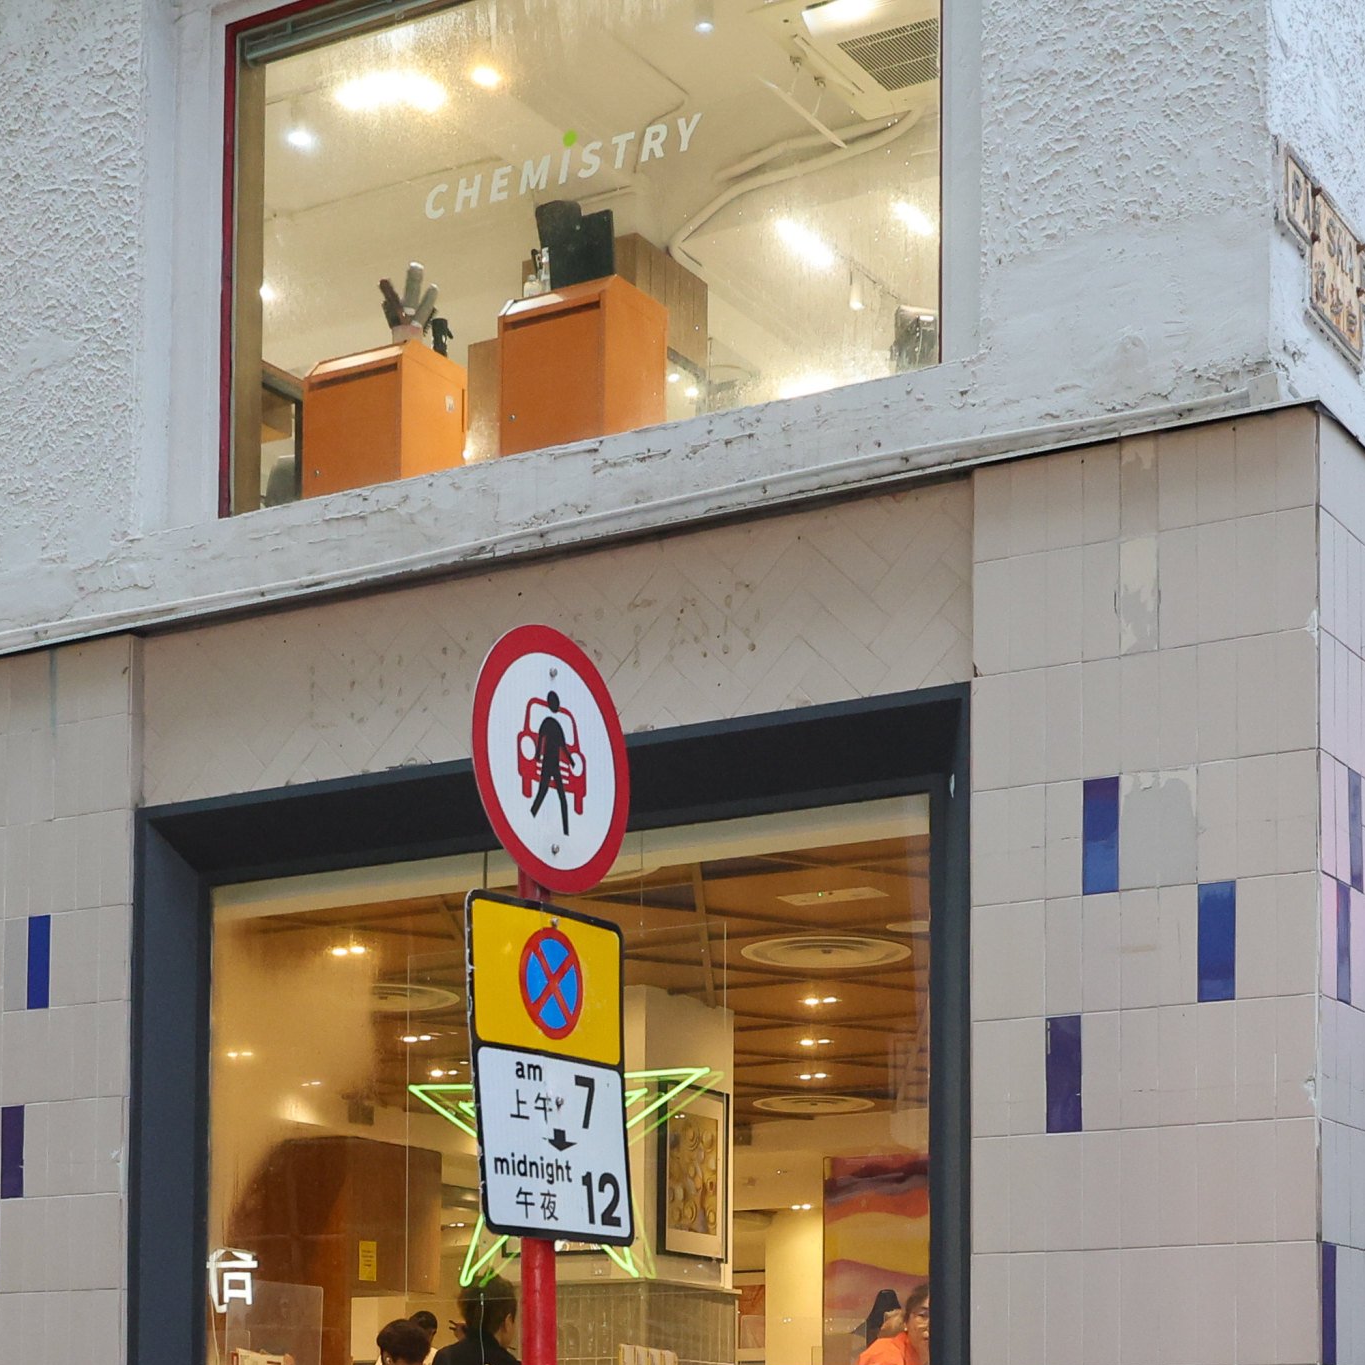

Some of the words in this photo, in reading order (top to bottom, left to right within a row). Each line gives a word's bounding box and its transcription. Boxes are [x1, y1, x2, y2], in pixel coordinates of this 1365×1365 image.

[510, 1089, 553, 1124] 上午
[515, 1061, 543, 1082] am
[574, 1074, 595, 1129] 7
[494, 1152, 573, 1185] midnight
[581, 1171, 622, 1227] 12
[516, 1187, 559, 1221] 午夜
